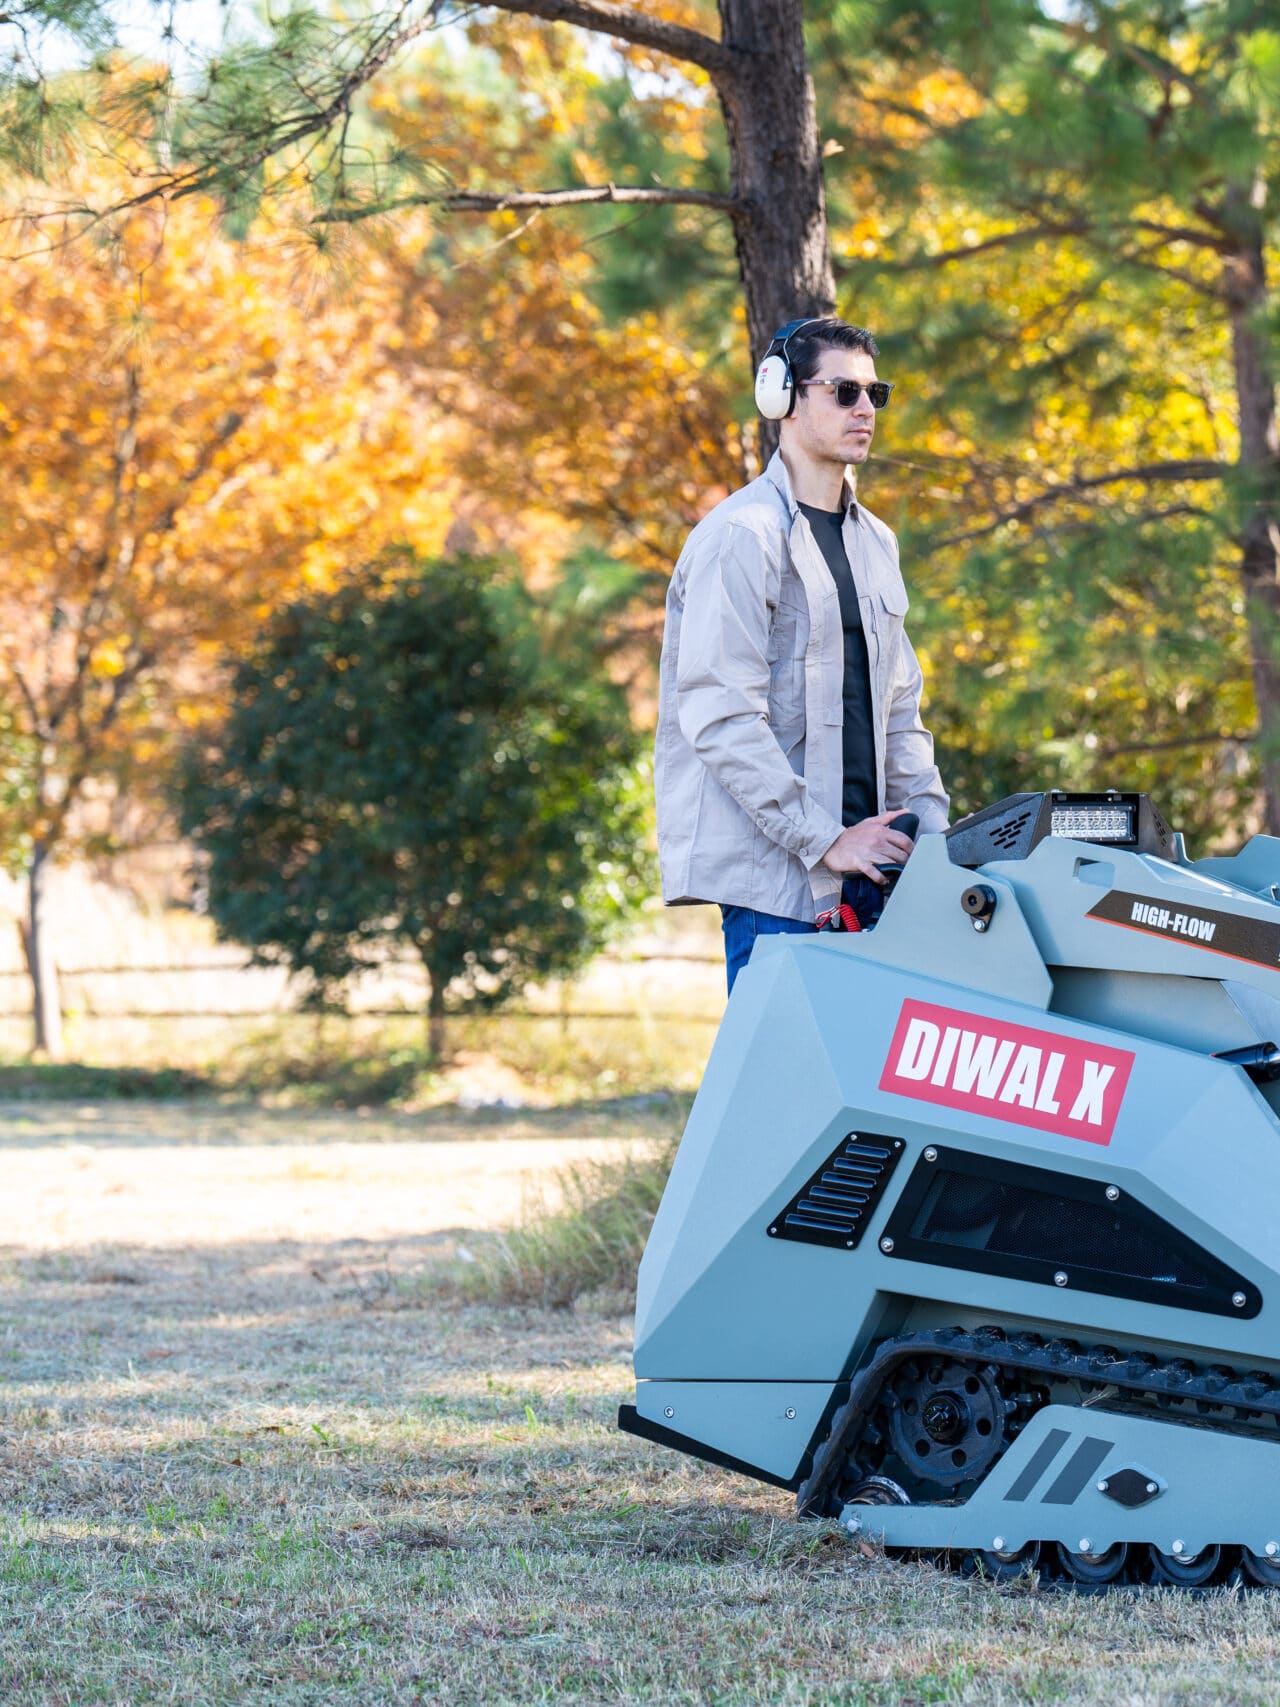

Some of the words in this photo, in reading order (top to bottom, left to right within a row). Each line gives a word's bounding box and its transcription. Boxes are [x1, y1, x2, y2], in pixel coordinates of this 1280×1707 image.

[1130, 901, 1216, 942] HIGH-FLOW
[895, 1017, 1066, 1115] DIWAL
[1068, 1059, 1116, 1126] X
